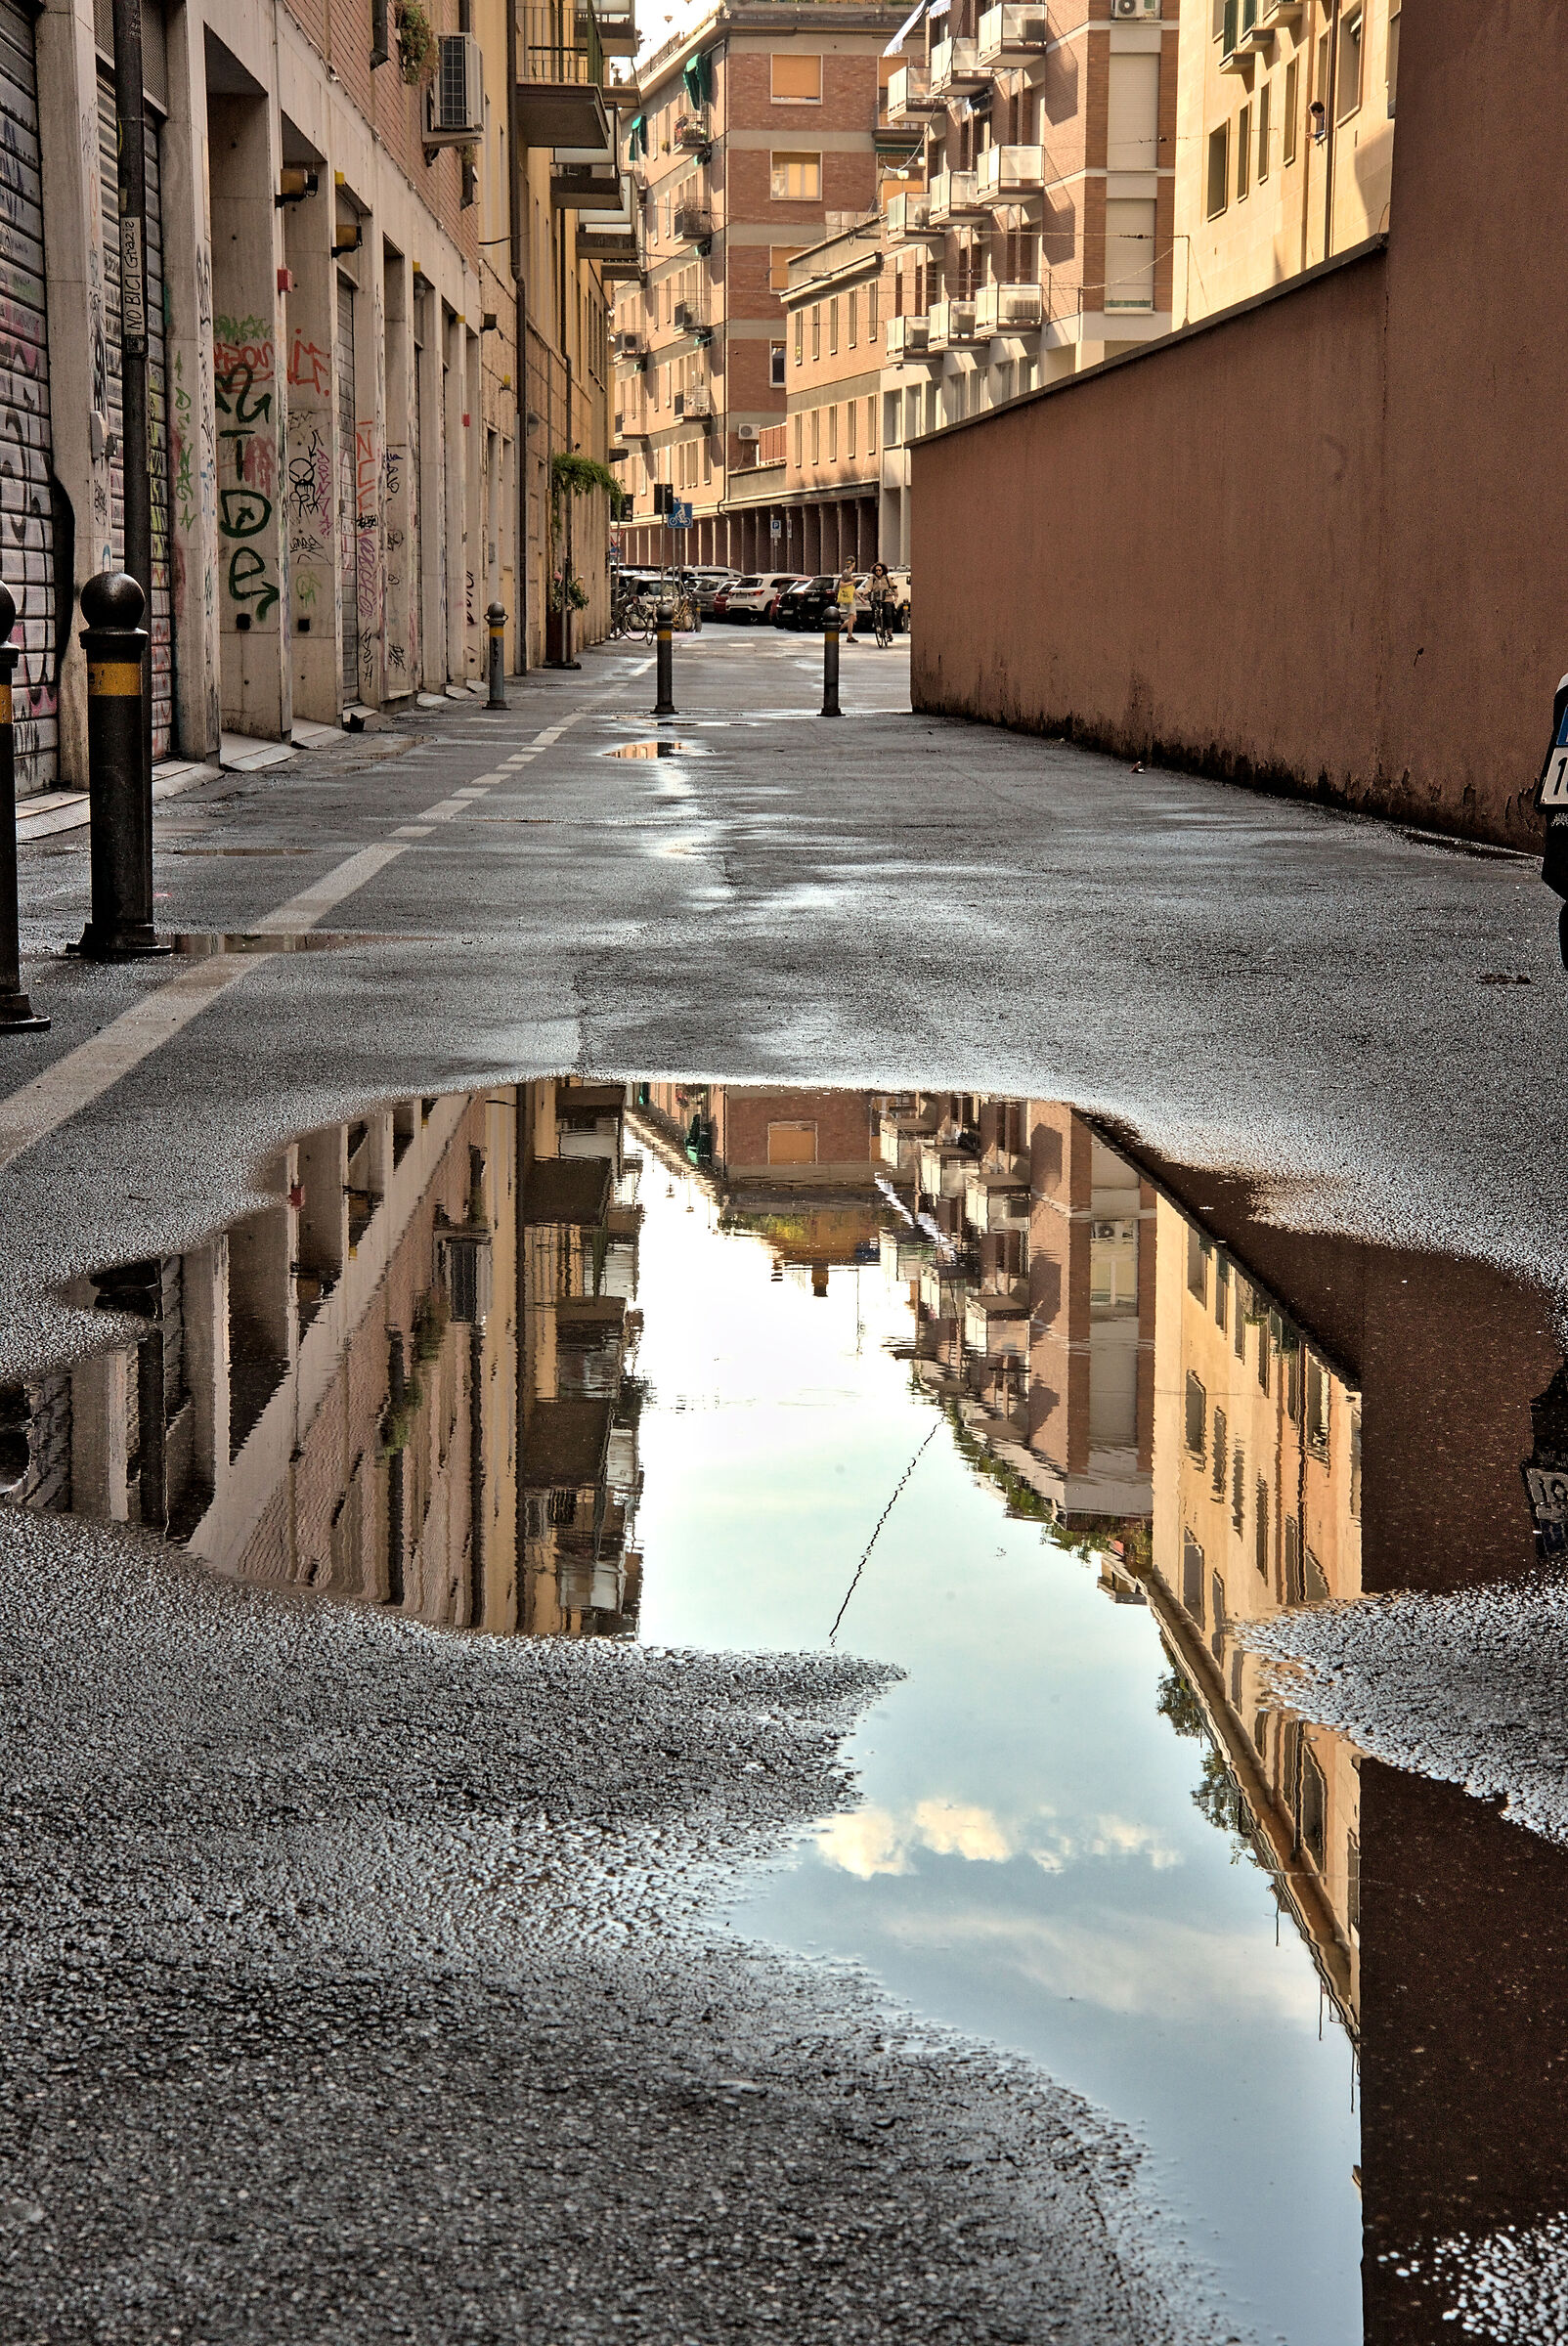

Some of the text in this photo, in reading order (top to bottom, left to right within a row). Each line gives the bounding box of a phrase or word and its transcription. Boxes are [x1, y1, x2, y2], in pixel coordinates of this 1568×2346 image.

[124, 220, 143, 330] NO BICI Grazie
